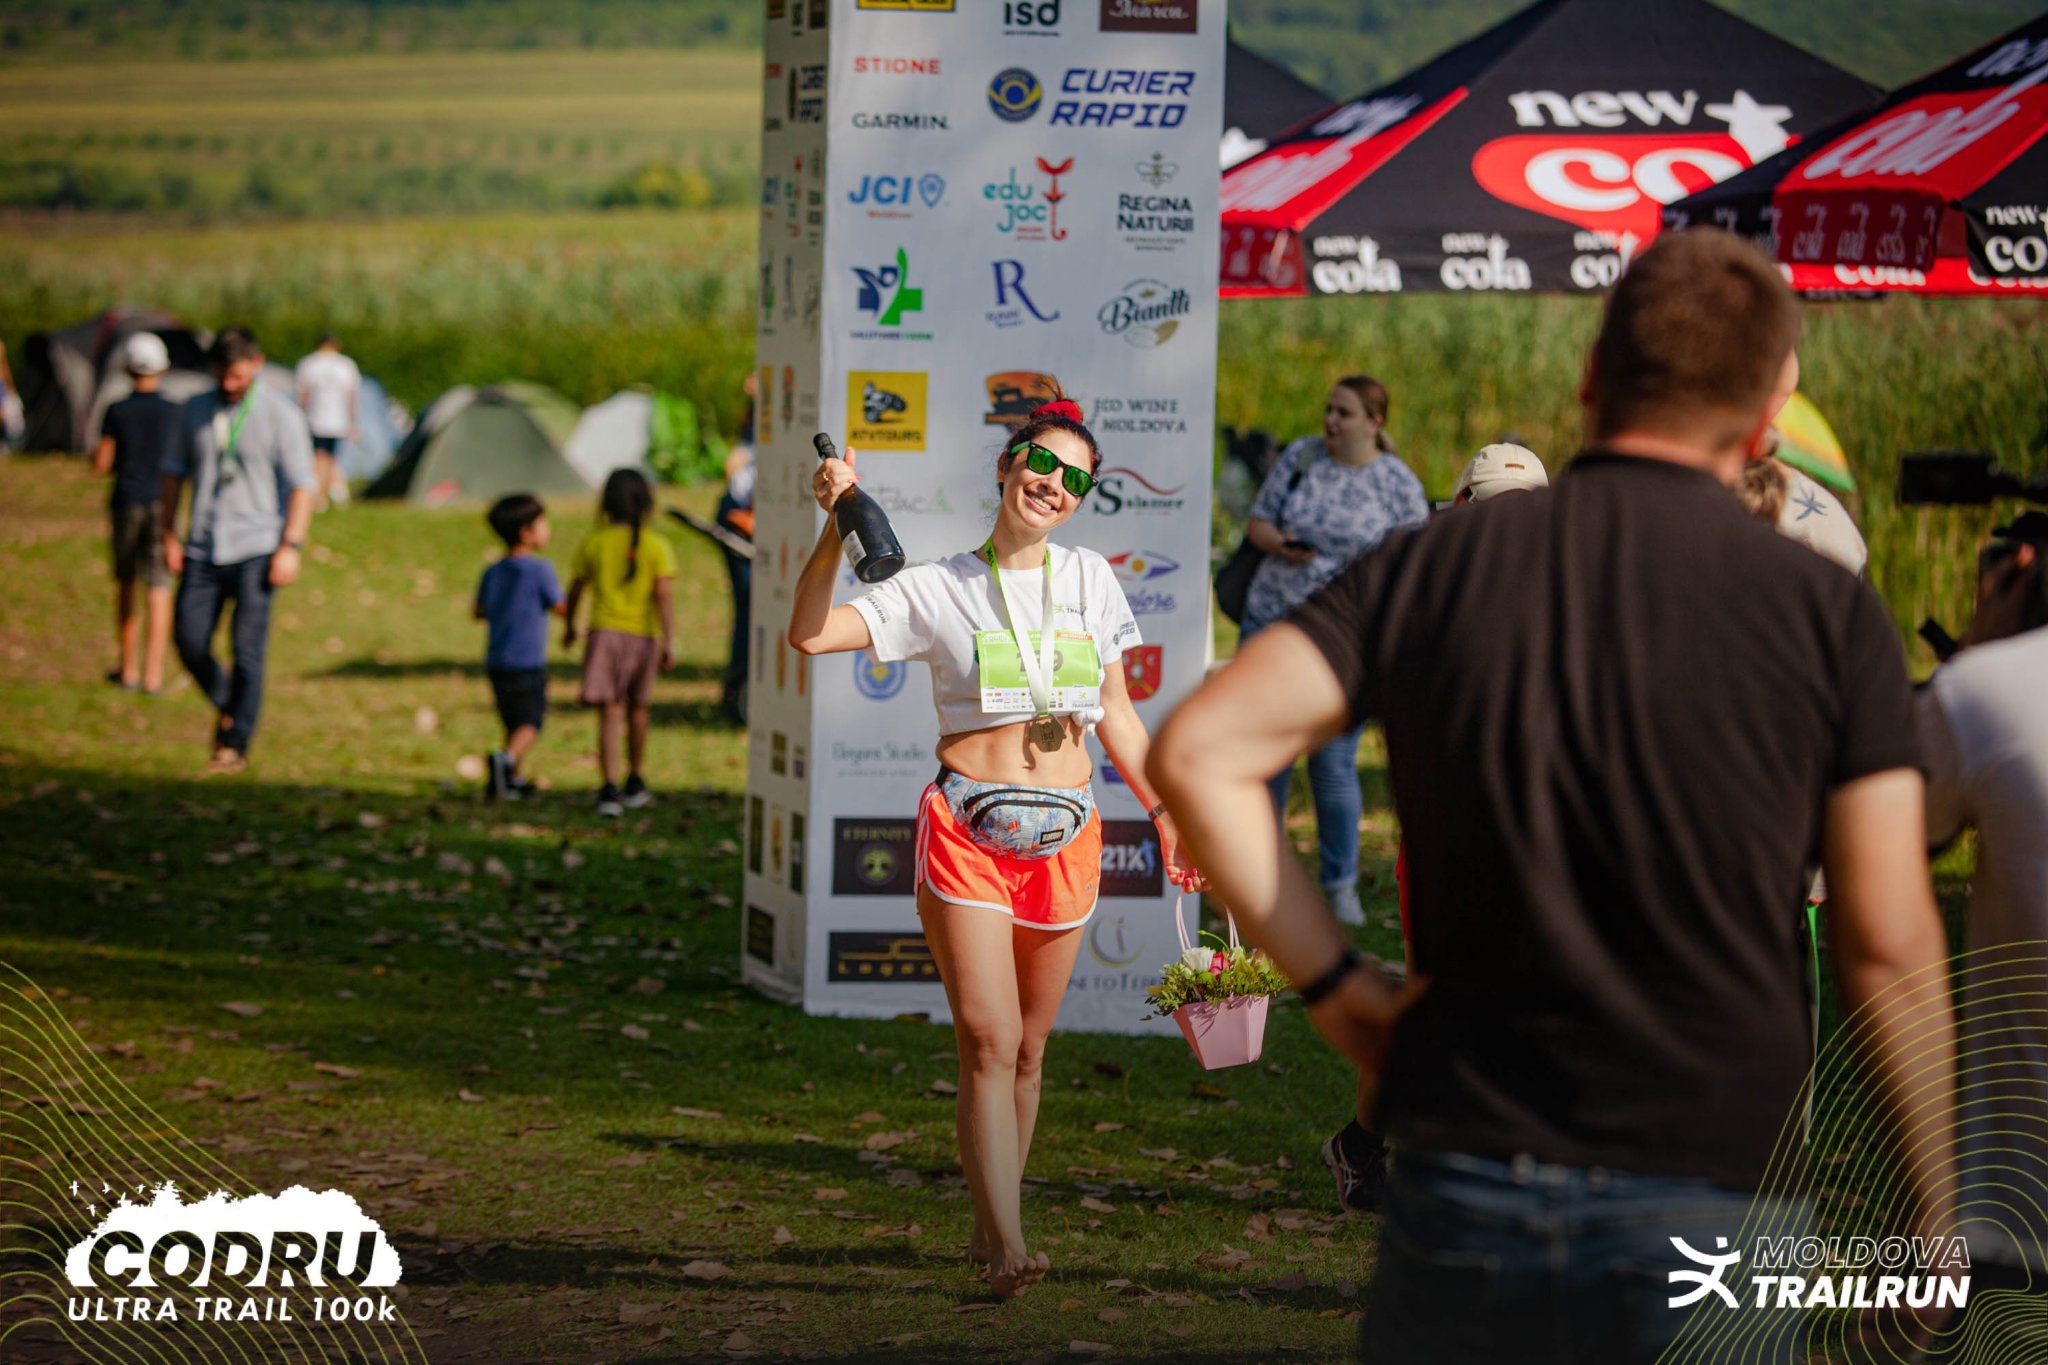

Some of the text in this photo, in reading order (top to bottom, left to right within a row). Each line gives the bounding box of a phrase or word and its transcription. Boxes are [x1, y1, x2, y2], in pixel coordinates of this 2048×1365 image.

[854, 56, 941, 75] STIONE
[1062, 68, 1196, 96] CURIER
[851, 112, 947, 130] GARMIN
[1051, 101, 1187, 128] RAPID
[1508, 88, 1698, 128] new
[848, 175, 912, 204] JCI
[982, 167, 1033, 201] edu
[1119, 193, 1193, 211] REGINA
[1985, 205, 2039, 226] new
[1313, 236, 1402, 293] cola
[1440, 232, 1532, 290] cola
